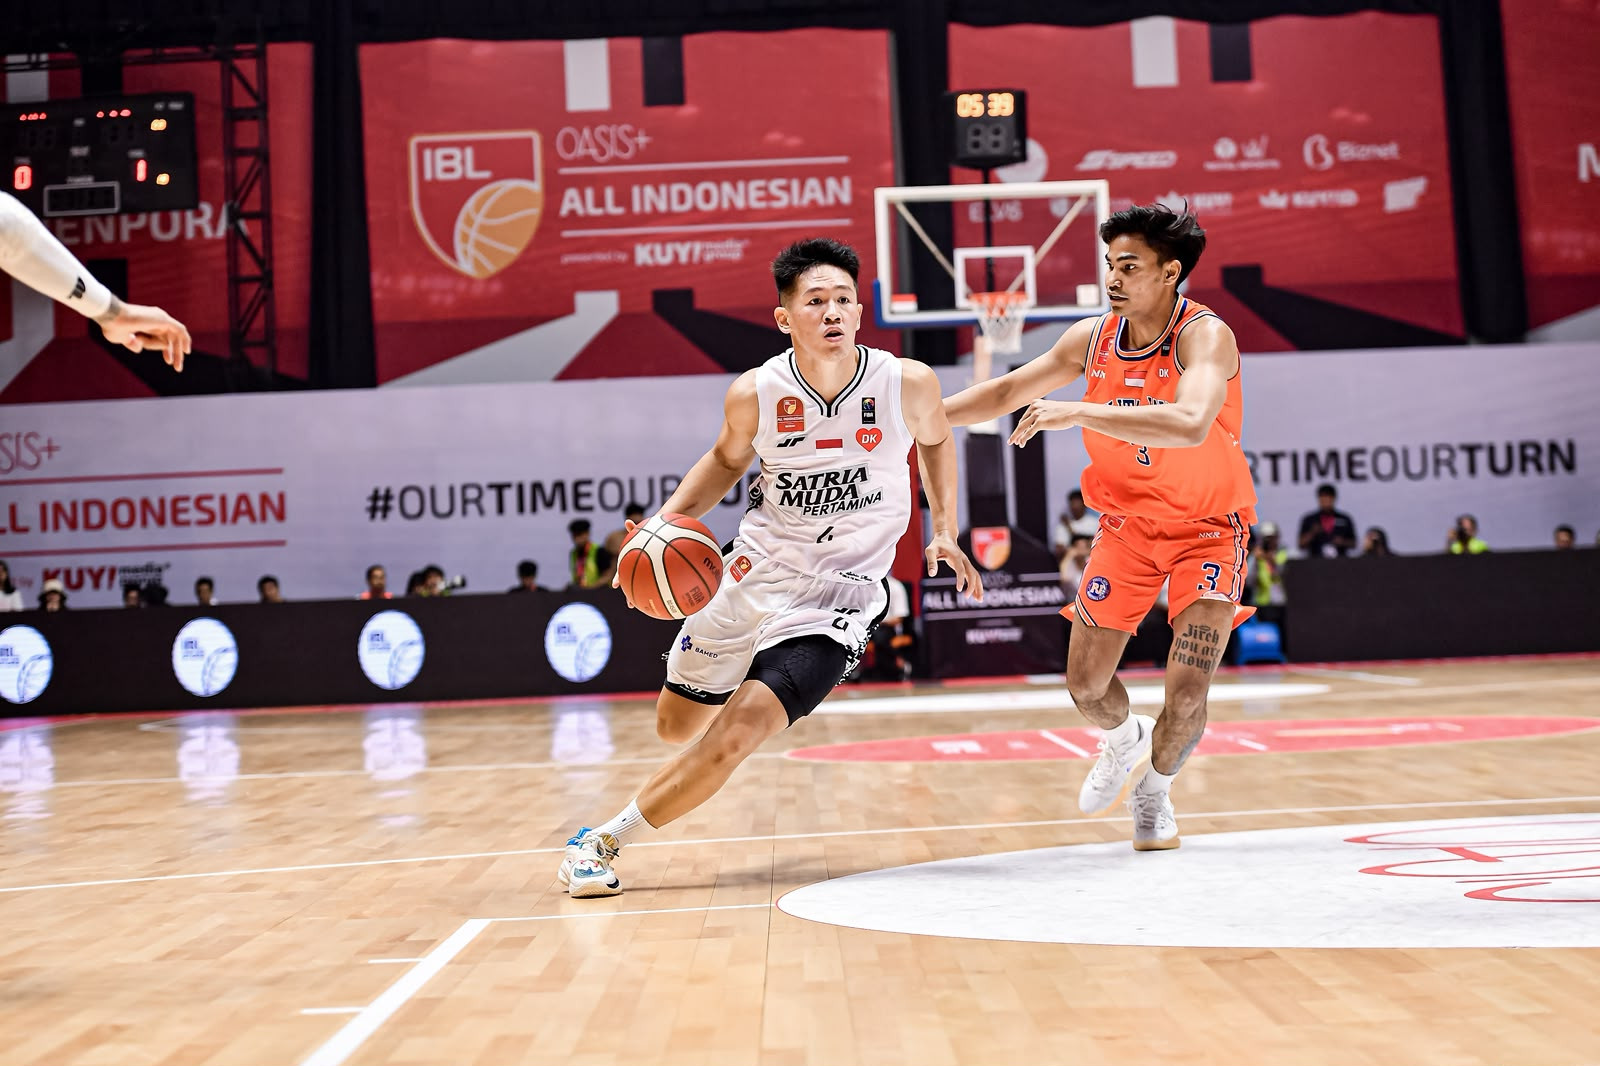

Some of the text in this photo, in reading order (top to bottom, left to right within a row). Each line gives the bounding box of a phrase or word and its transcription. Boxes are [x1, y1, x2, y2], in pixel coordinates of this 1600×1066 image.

[957, 93, 984, 117] 05
[556, 124, 652, 162] OASIS+
[423, 147, 492, 181] IBL
[560, 176, 853, 217] ALL INDONESIAN
[1158, 369, 1169, 378] DK
[861, 434, 877, 444] DK
[775, 466, 869, 491] SATRIA
[778, 484, 860, 509] MUDA
[802, 491, 882, 516] PERTAMINA
[40, 491, 287, 533] INDONESIAN
[1197, 562, 1222, 591] 3
[694, 647, 719, 659] BAMED
